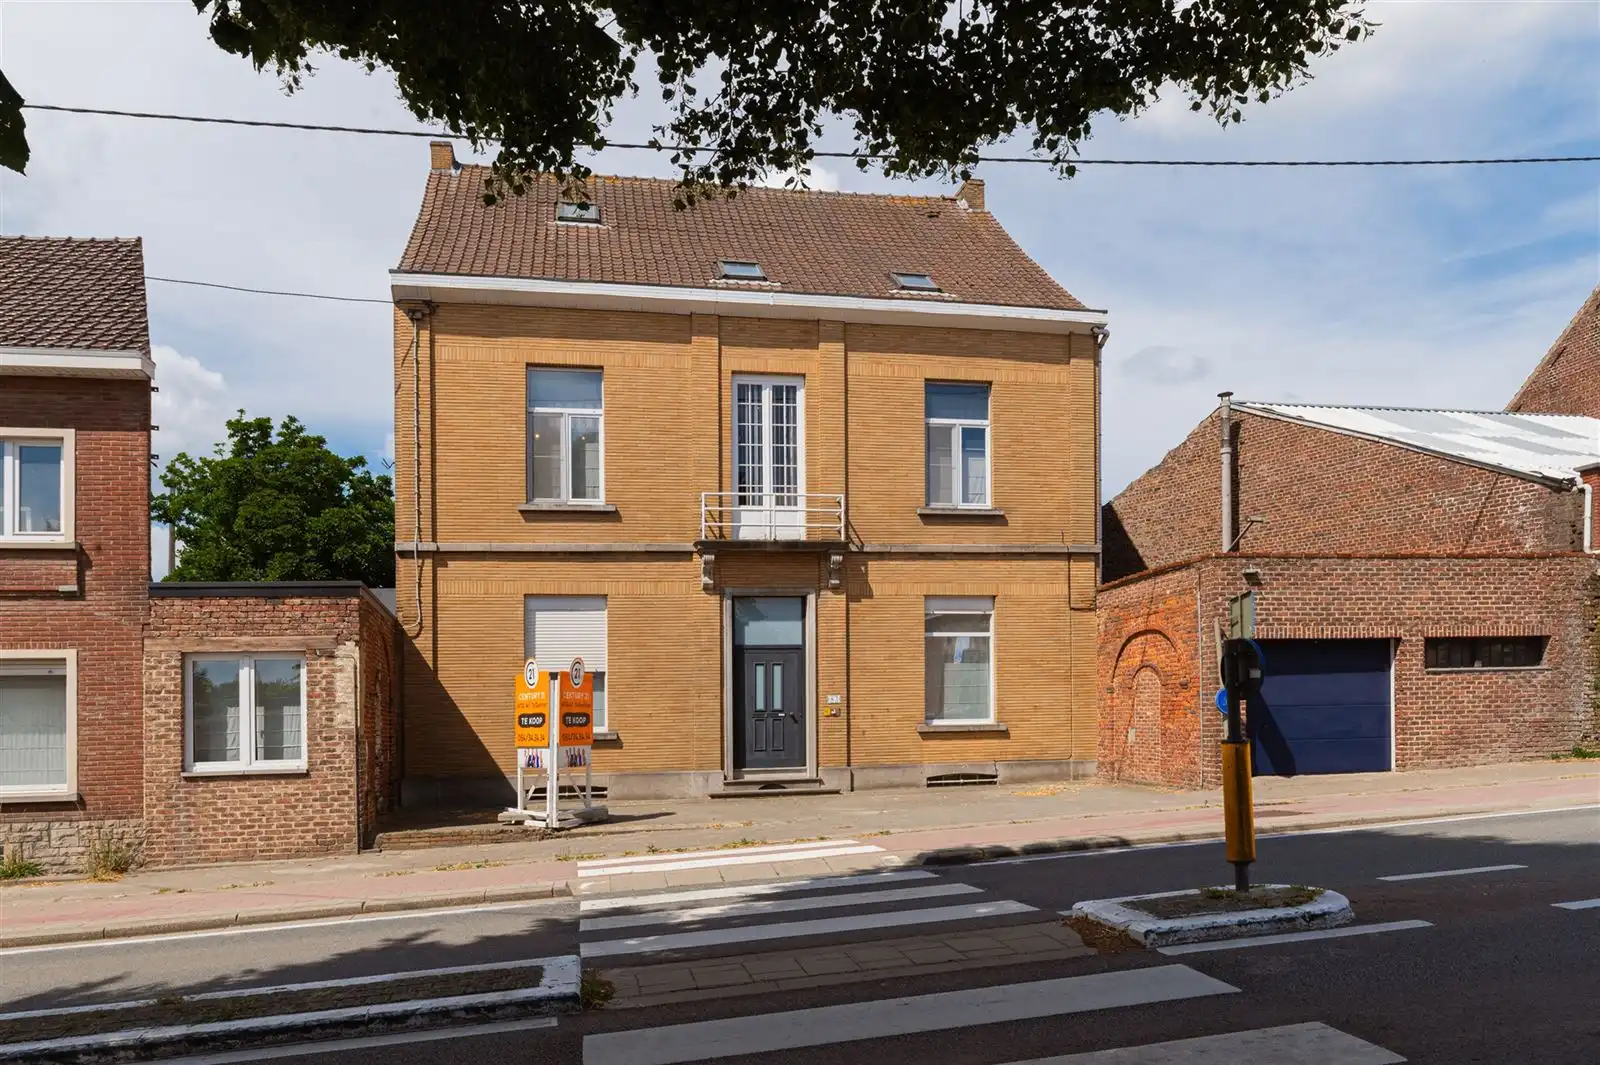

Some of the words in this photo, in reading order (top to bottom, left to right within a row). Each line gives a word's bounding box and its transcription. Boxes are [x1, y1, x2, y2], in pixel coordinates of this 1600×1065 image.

[519, 692, 540, 701] CENTURY
[521, 717, 528, 725] TE
[529, 716, 543, 725] KOOP
[565, 716, 571, 724] TE
[572, 716, 587, 724] KOOP
